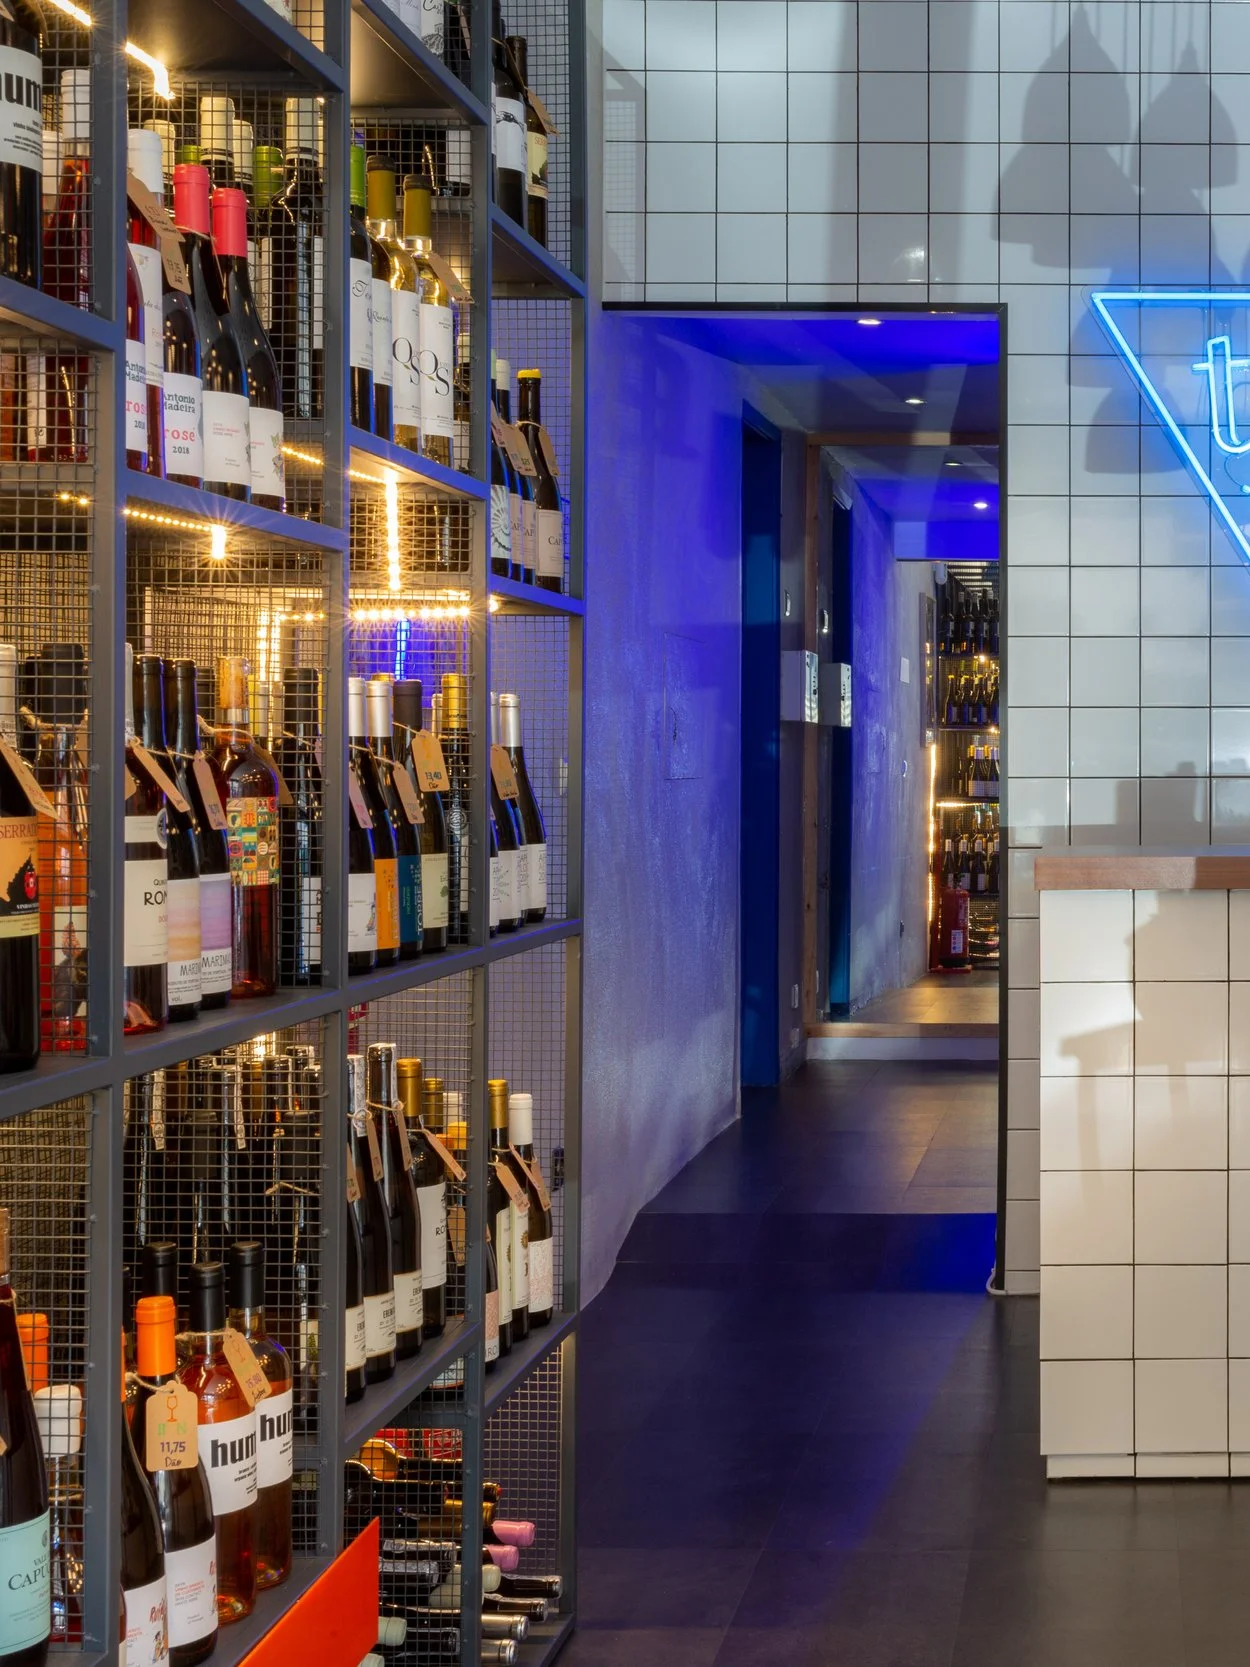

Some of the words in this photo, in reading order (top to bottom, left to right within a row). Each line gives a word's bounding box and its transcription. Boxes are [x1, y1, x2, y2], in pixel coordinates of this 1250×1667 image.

[0, 72, 42, 114] um
[126, 400, 147, 415] ros
[160, 1441, 186, 1455] 11,75
